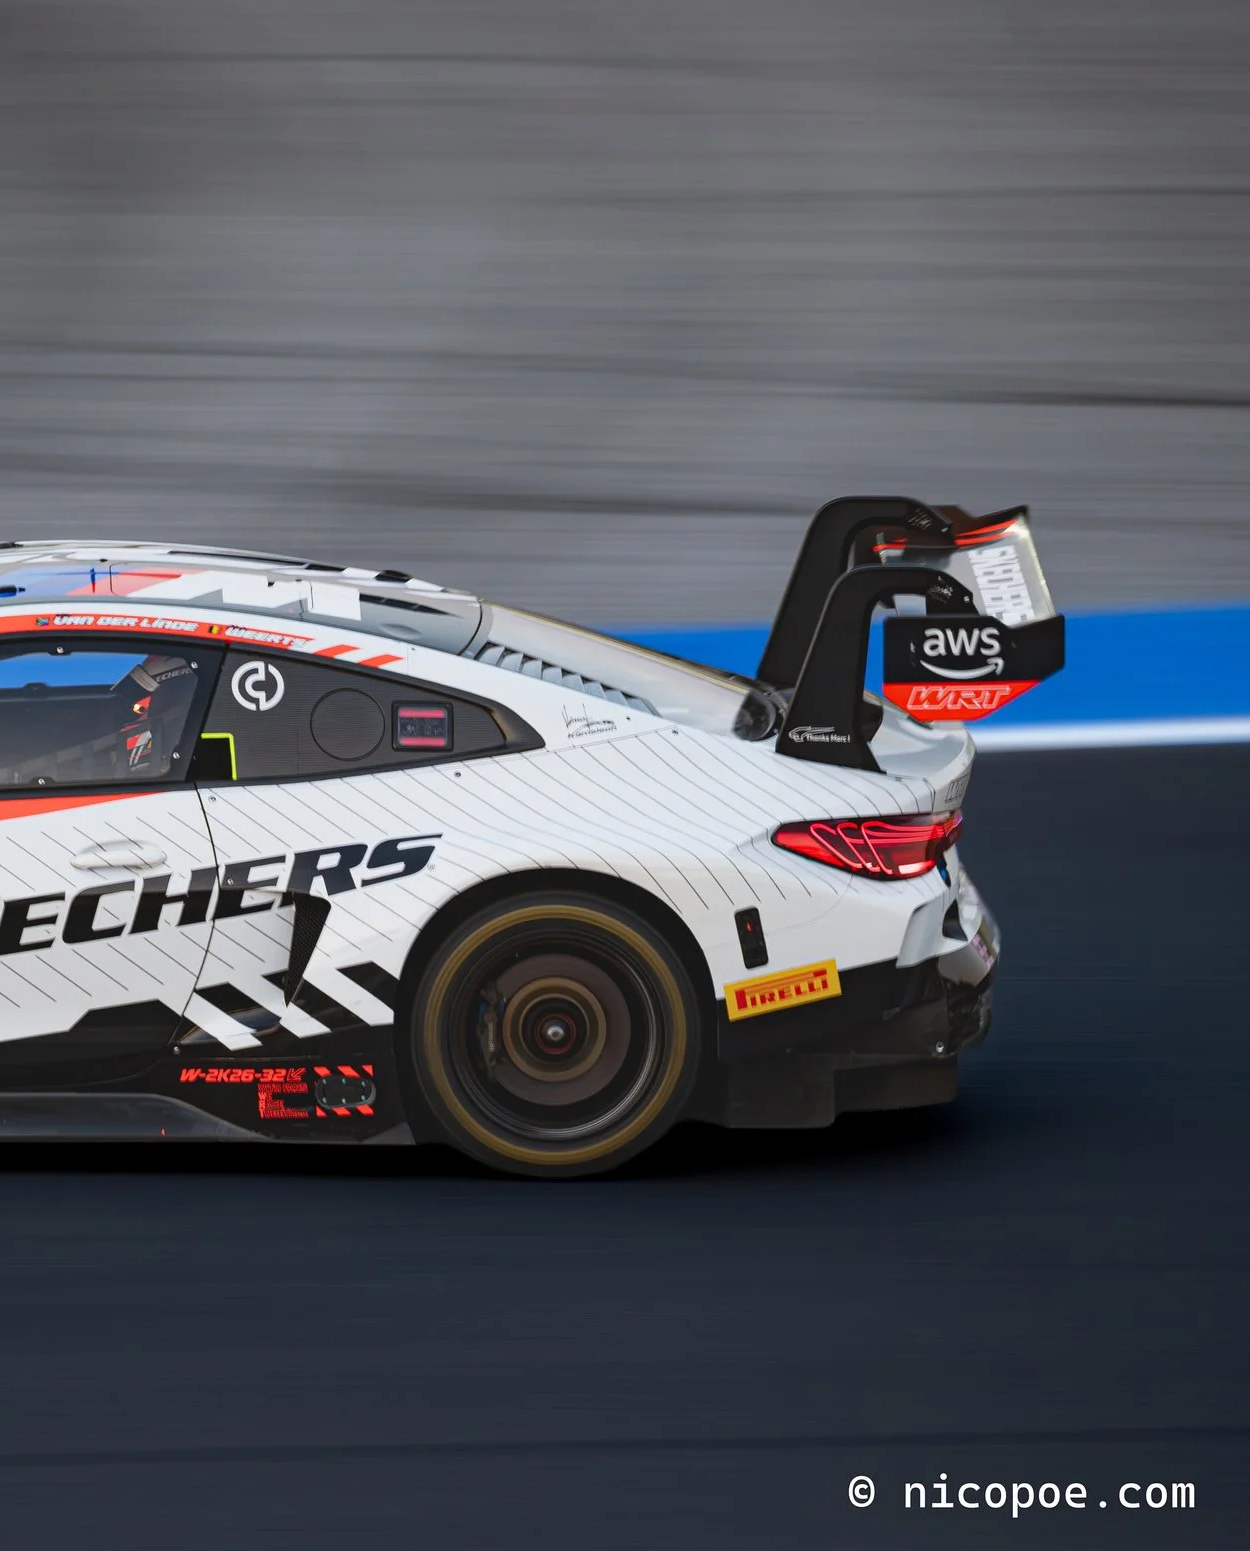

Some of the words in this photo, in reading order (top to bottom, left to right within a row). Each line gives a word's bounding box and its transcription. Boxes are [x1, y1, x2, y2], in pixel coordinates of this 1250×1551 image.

[53, 614, 94, 626] VAN
[97, 615, 139, 628] DER
[923, 627, 1001, 657] aws
[907, 685, 1011, 710] WRT
[806, 734, 829, 743] Thanks
[734, 968, 828, 1011] PIRELLI
